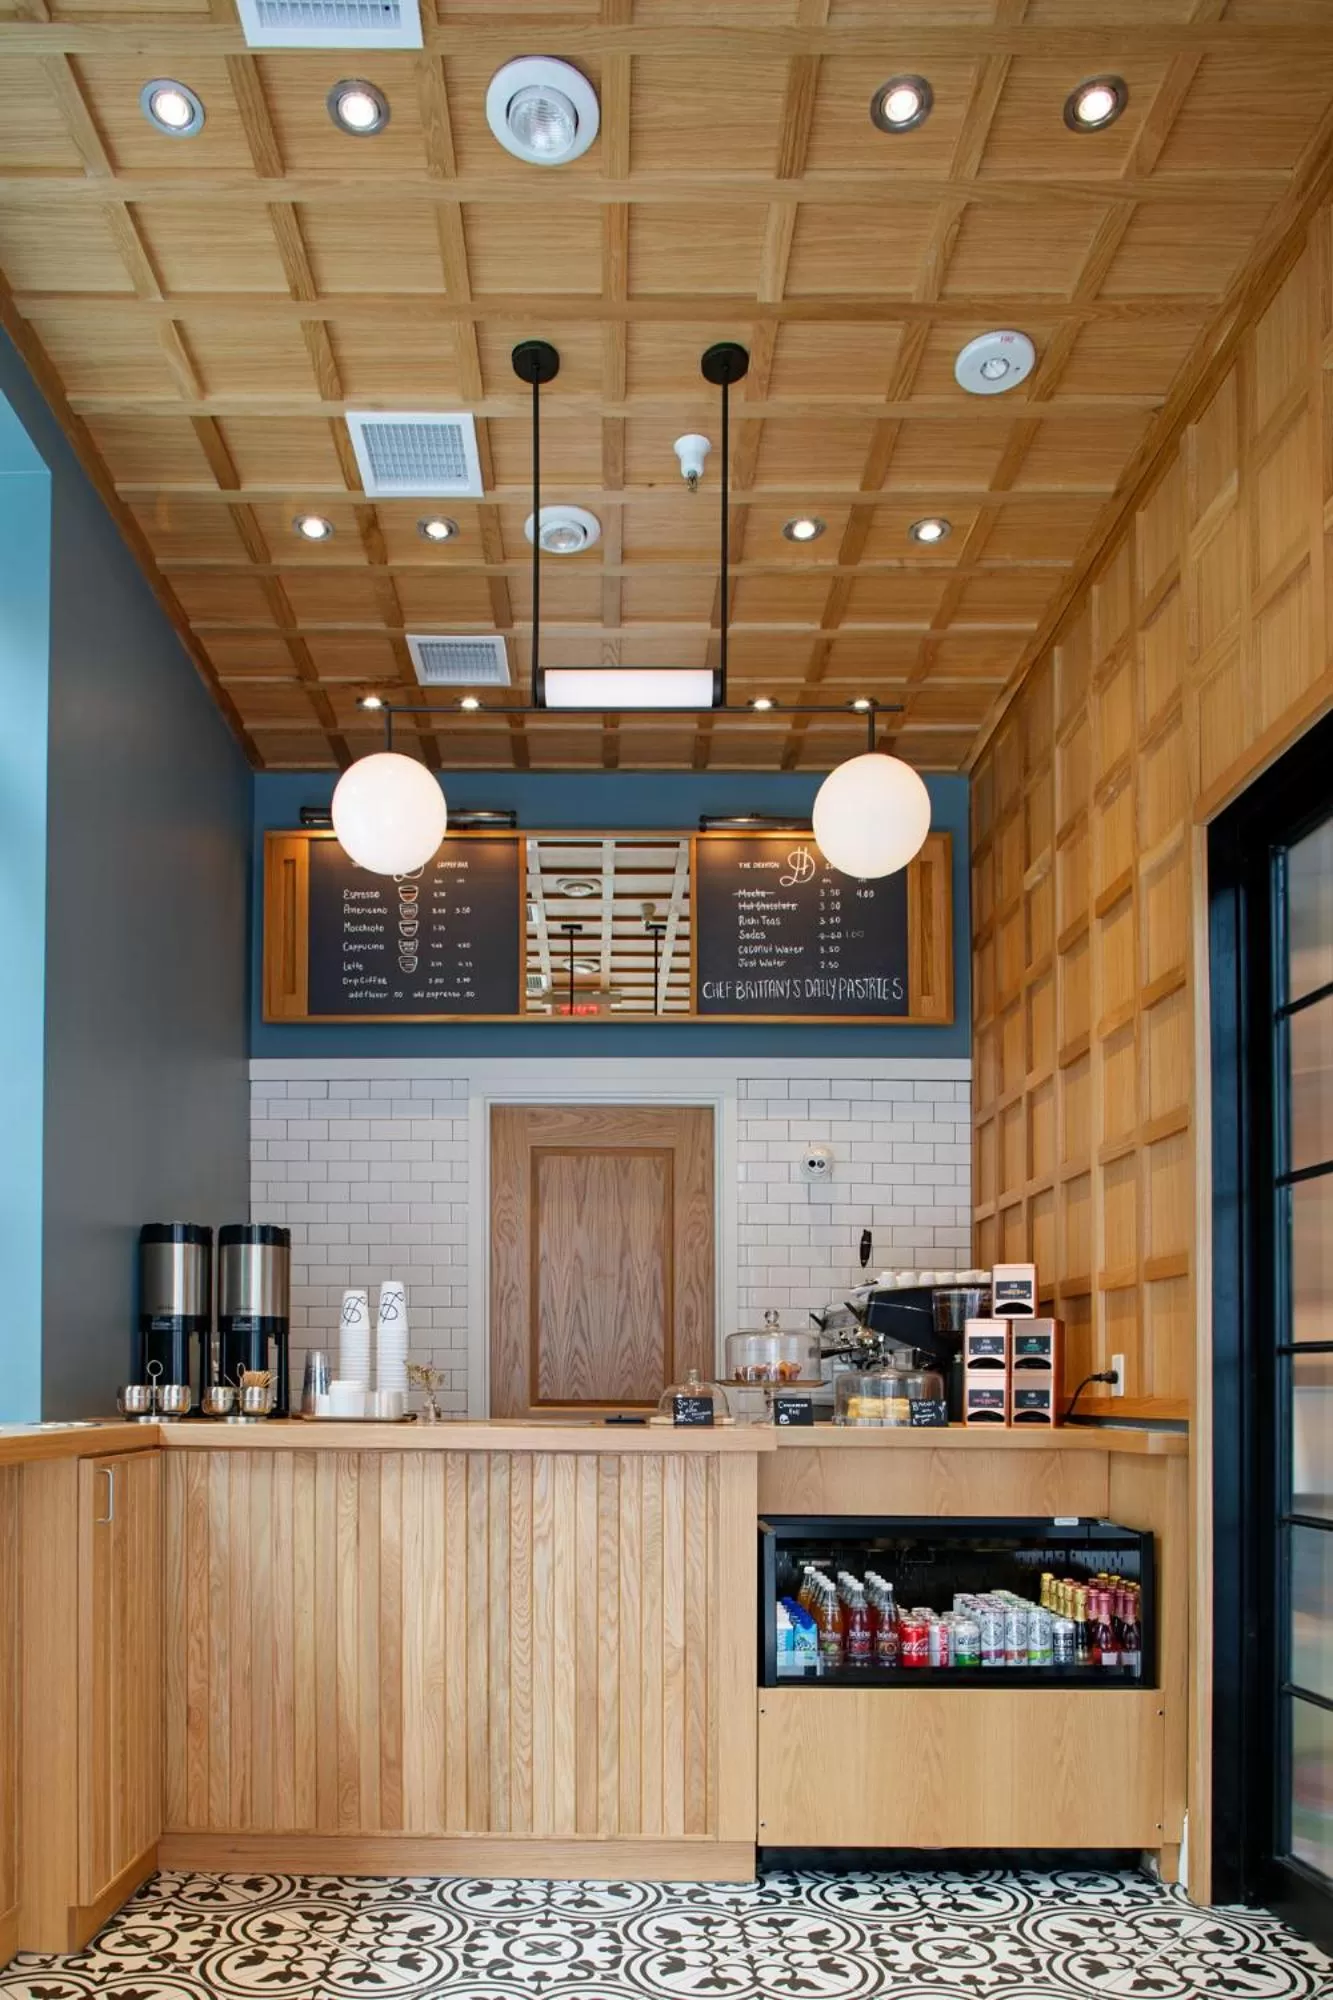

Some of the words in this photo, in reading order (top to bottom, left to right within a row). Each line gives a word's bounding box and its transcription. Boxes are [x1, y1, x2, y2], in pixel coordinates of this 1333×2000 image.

[343, 889, 381, 900] Espresso
[343, 903, 389, 915] Americano
[738, 915, 761, 926] Rishi
[761, 915, 782, 926] Teas
[737, 944, 773, 954] Coconut
[775, 944, 805, 954] Water
[737, 958, 757, 968] Just
[759, 958, 786, 968] Water
[702, 980, 733, 1000] CHEF
[804, 977, 838, 1000] DAILY
[838, 976, 904, 1001] PASTRIES
